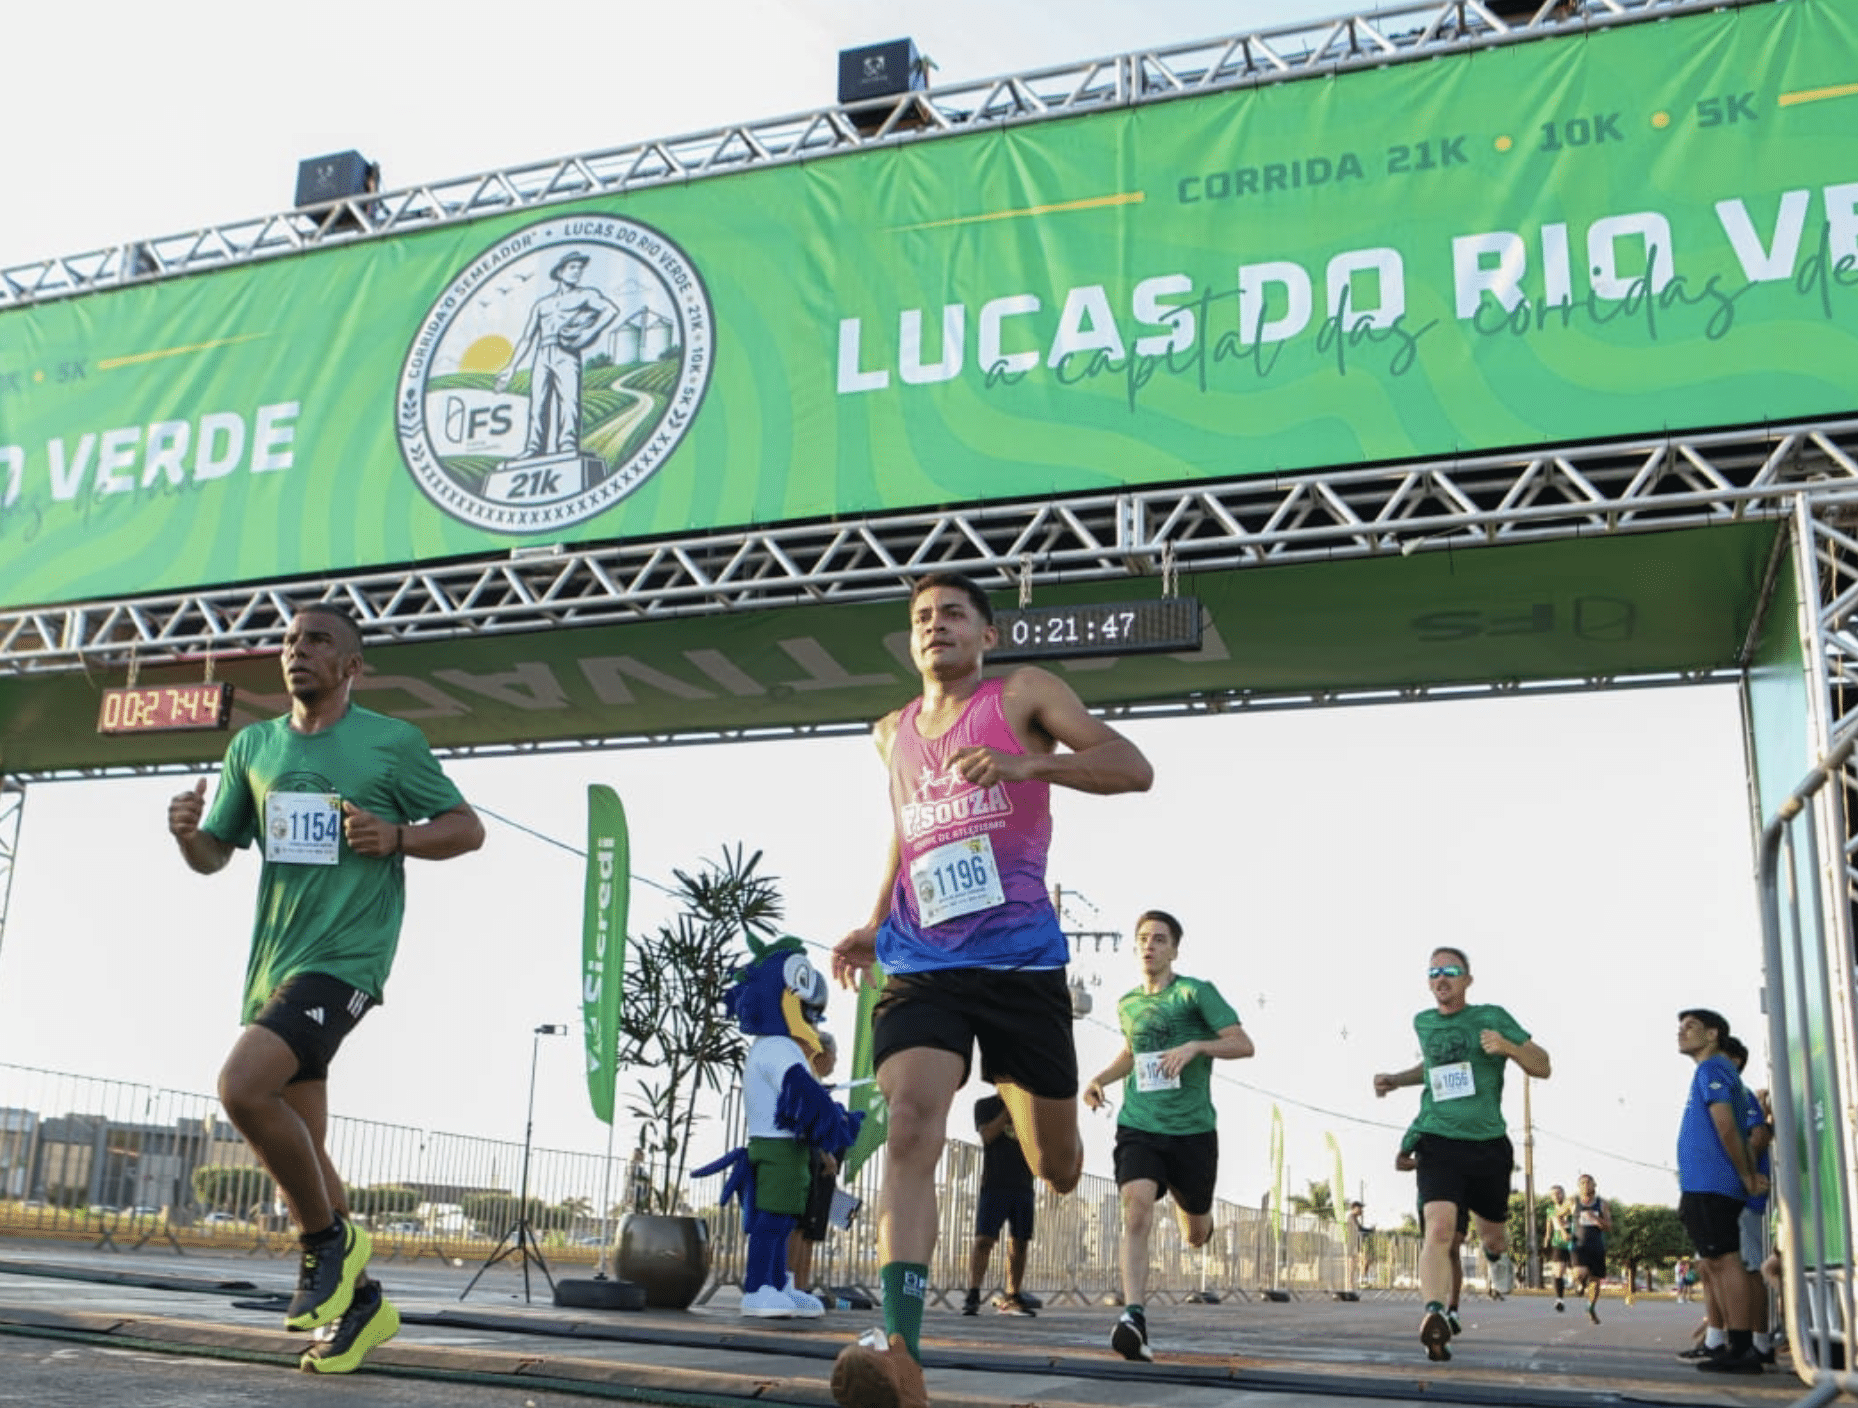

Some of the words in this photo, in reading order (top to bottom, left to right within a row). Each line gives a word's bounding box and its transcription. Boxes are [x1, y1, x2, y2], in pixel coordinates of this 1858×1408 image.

[1177, 152, 1364, 205] CORRIDA
[1387, 136, 1469, 175] 21K
[1540, 113, 1624, 152] 10K
[1696, 91, 1758, 128] 5K
[564, 222, 614, 237] LUCAS
[615, 227, 638, 245] DO
[637, 235, 661, 257] RIO
[659, 250, 692, 294] VERDE
[687, 305, 703, 333] 21K
[837, 273, 1195, 394] LUCAS
[1238, 247, 1405, 345] DO
[1452, 211, 1675, 320] RIO
[984, 358, 1027, 389] a
[1056, 286, 1286, 413] capital
[1317, 283, 1439, 376] das
[1473, 243, 1758, 341] corridas
[408, 311, 447, 379] CORRIDA
[688, 346, 703, 374] 10K
[468, 404, 512, 440] FS
[47, 401, 300, 500] VERDE
[1012, 612, 1135, 645] 0:21:47
[104, 689, 219, 728] 00:27:44
[290, 811, 338, 841] 1154
[934, 855, 988, 896] 1196
[583, 837, 615, 1003] Sicredi
